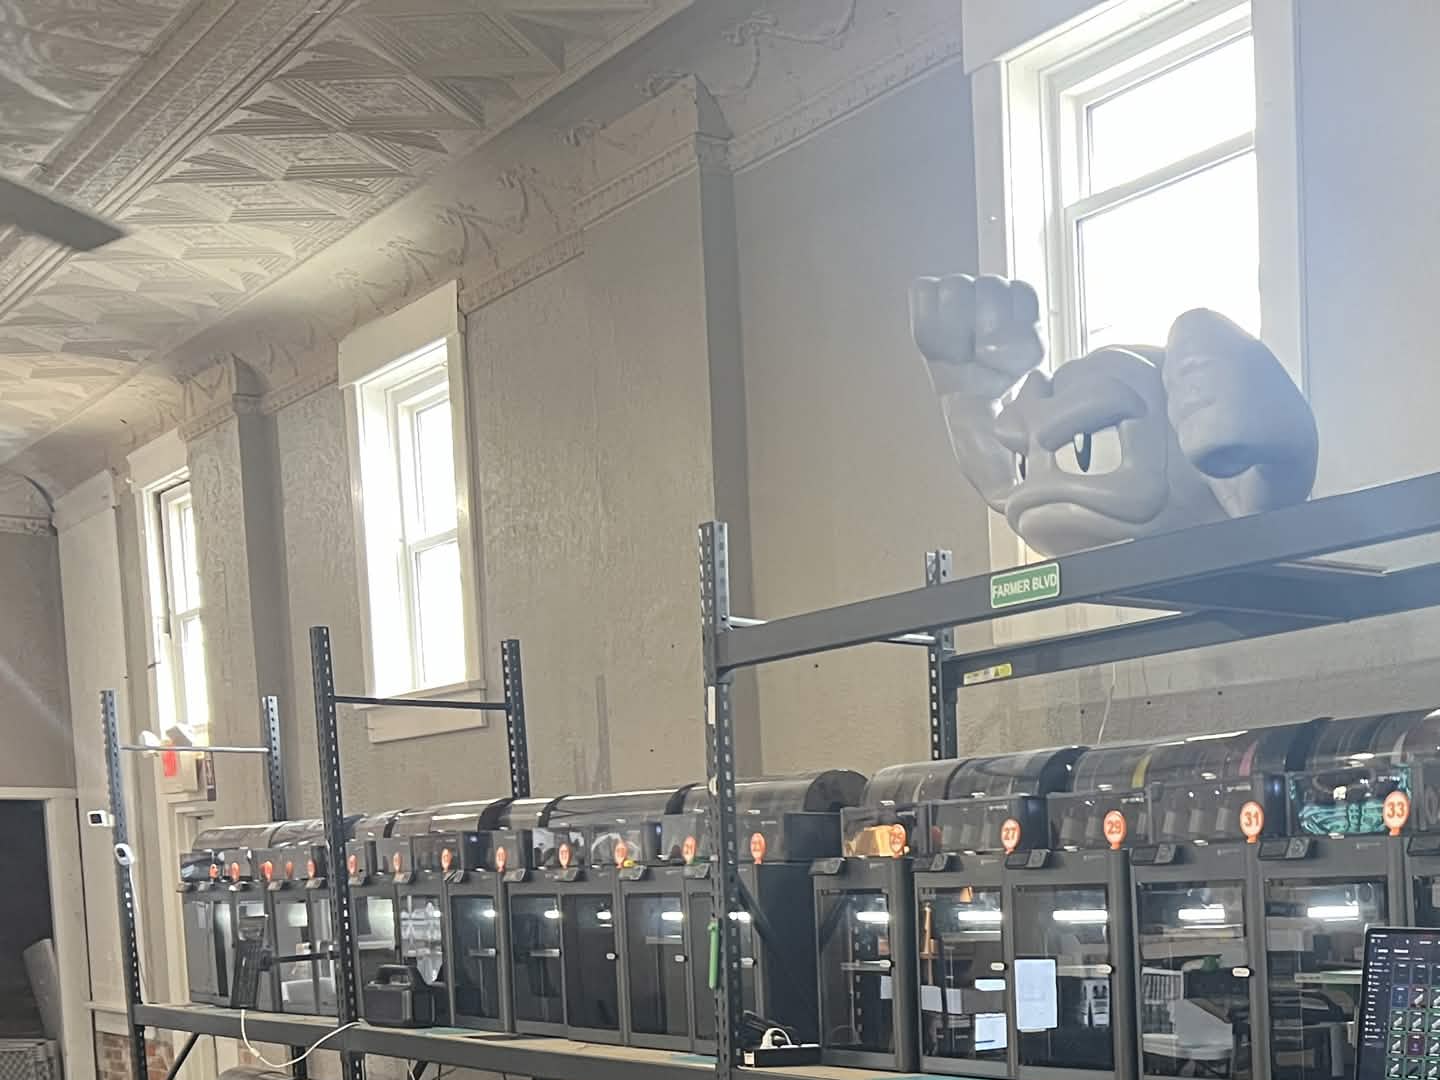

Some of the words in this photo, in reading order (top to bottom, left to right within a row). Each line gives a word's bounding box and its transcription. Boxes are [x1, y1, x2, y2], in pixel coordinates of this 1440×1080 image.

[992, 579, 1031, 599] FARMER
[1032, 574, 1058, 591] BLVD
[1243, 811, 1260, 828] 31
[1386, 801, 1405, 820] 33
